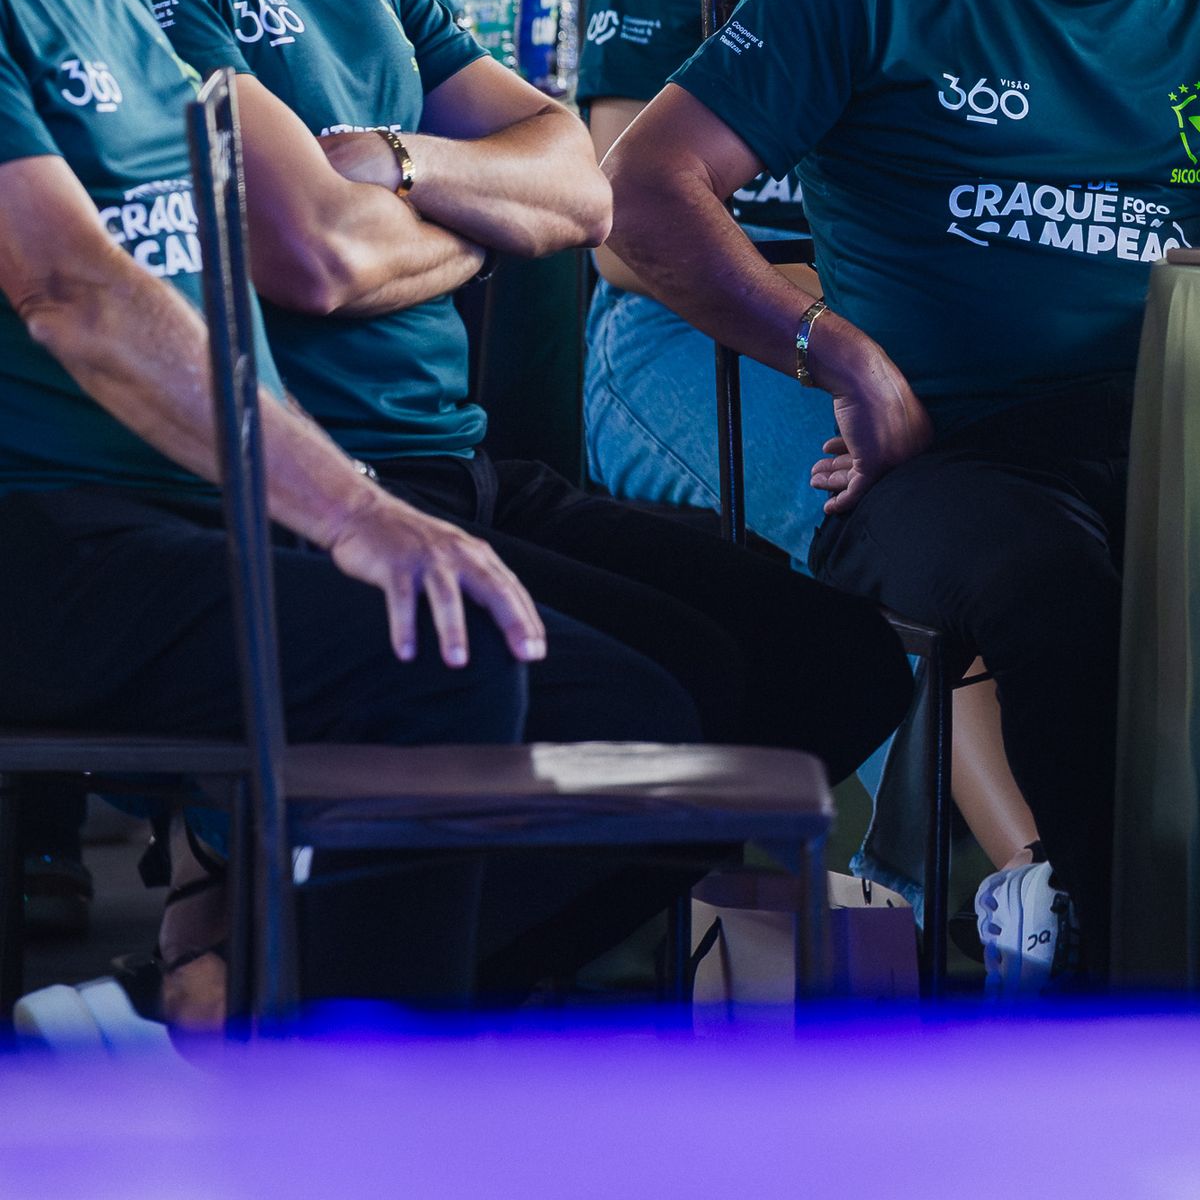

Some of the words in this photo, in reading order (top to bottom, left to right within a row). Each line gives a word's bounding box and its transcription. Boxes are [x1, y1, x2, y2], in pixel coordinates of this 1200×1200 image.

[731, 20, 759, 43] Cooperar
[1000, 78, 1031, 91] VISÃO
[938, 73, 1030, 121] 360
[948, 181, 1119, 223] CRAQUE
[1122, 196, 1171, 216] FOCO
[1121, 212, 1147, 226] DE
